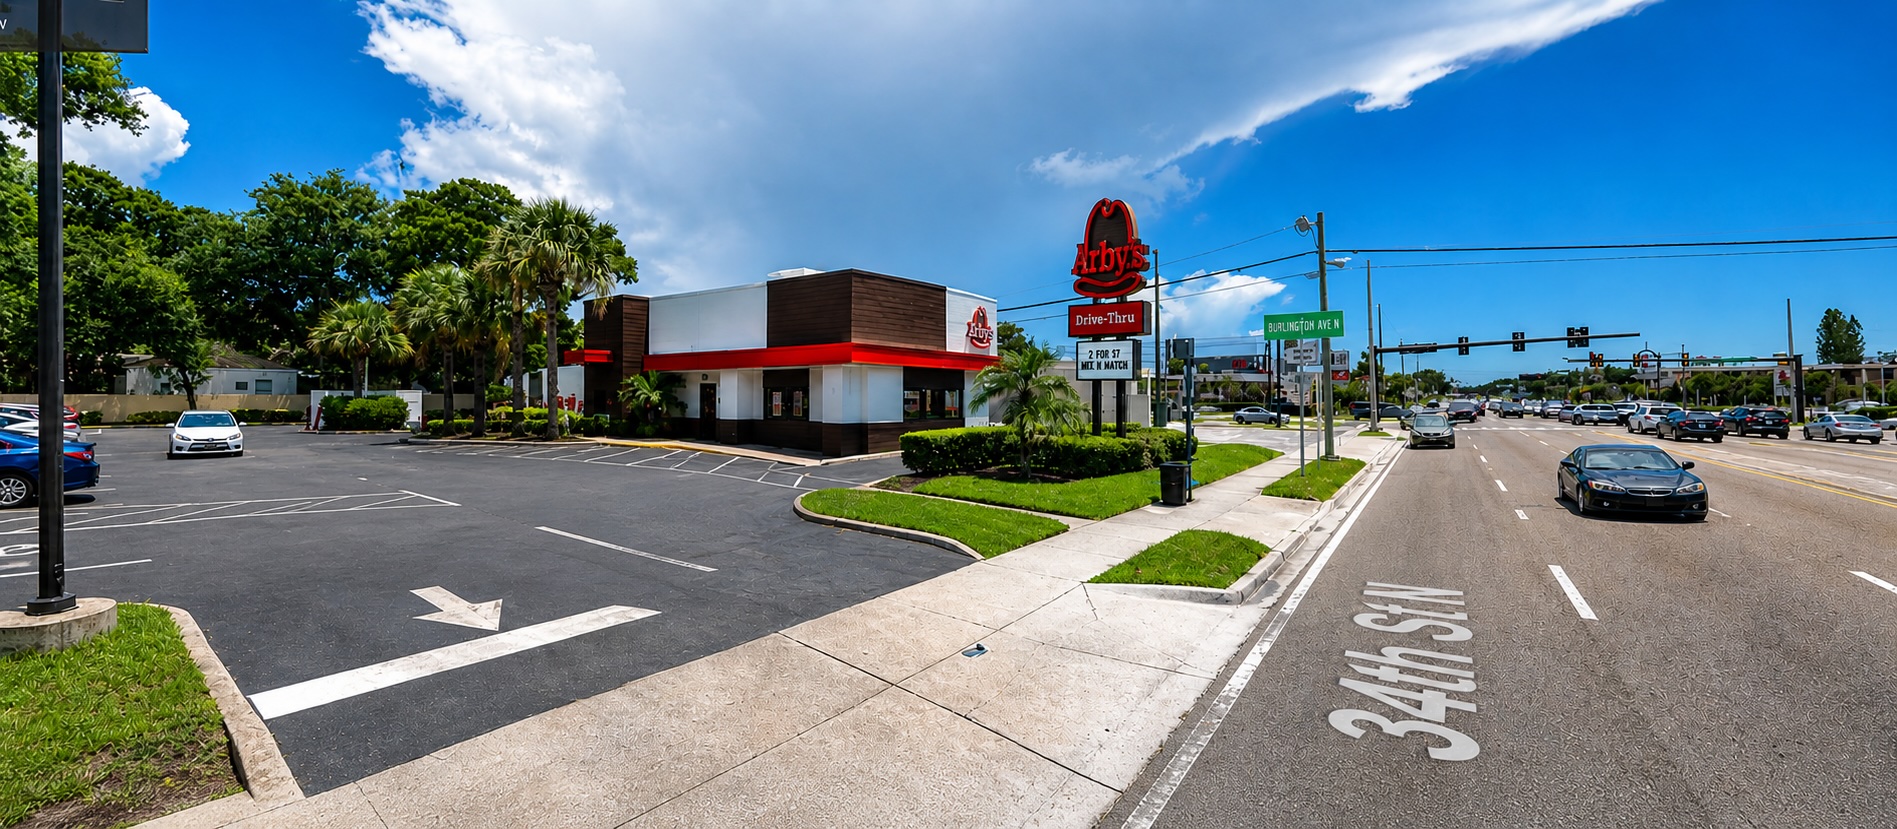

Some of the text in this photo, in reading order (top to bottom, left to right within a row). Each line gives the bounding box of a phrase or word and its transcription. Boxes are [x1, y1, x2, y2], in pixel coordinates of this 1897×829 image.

[1071, 240, 1146, 277] Arby's
[1075, 311, 1135, 326] Drive-Thru
[1268, 318, 1340, 334] BURLINGTON AVE N
[1088, 350, 1093, 359] 2
[1096, 349, 1110, 359] FOR
[1096, 360, 1102, 370] N
[1104, 360, 1128, 370] MATCH
